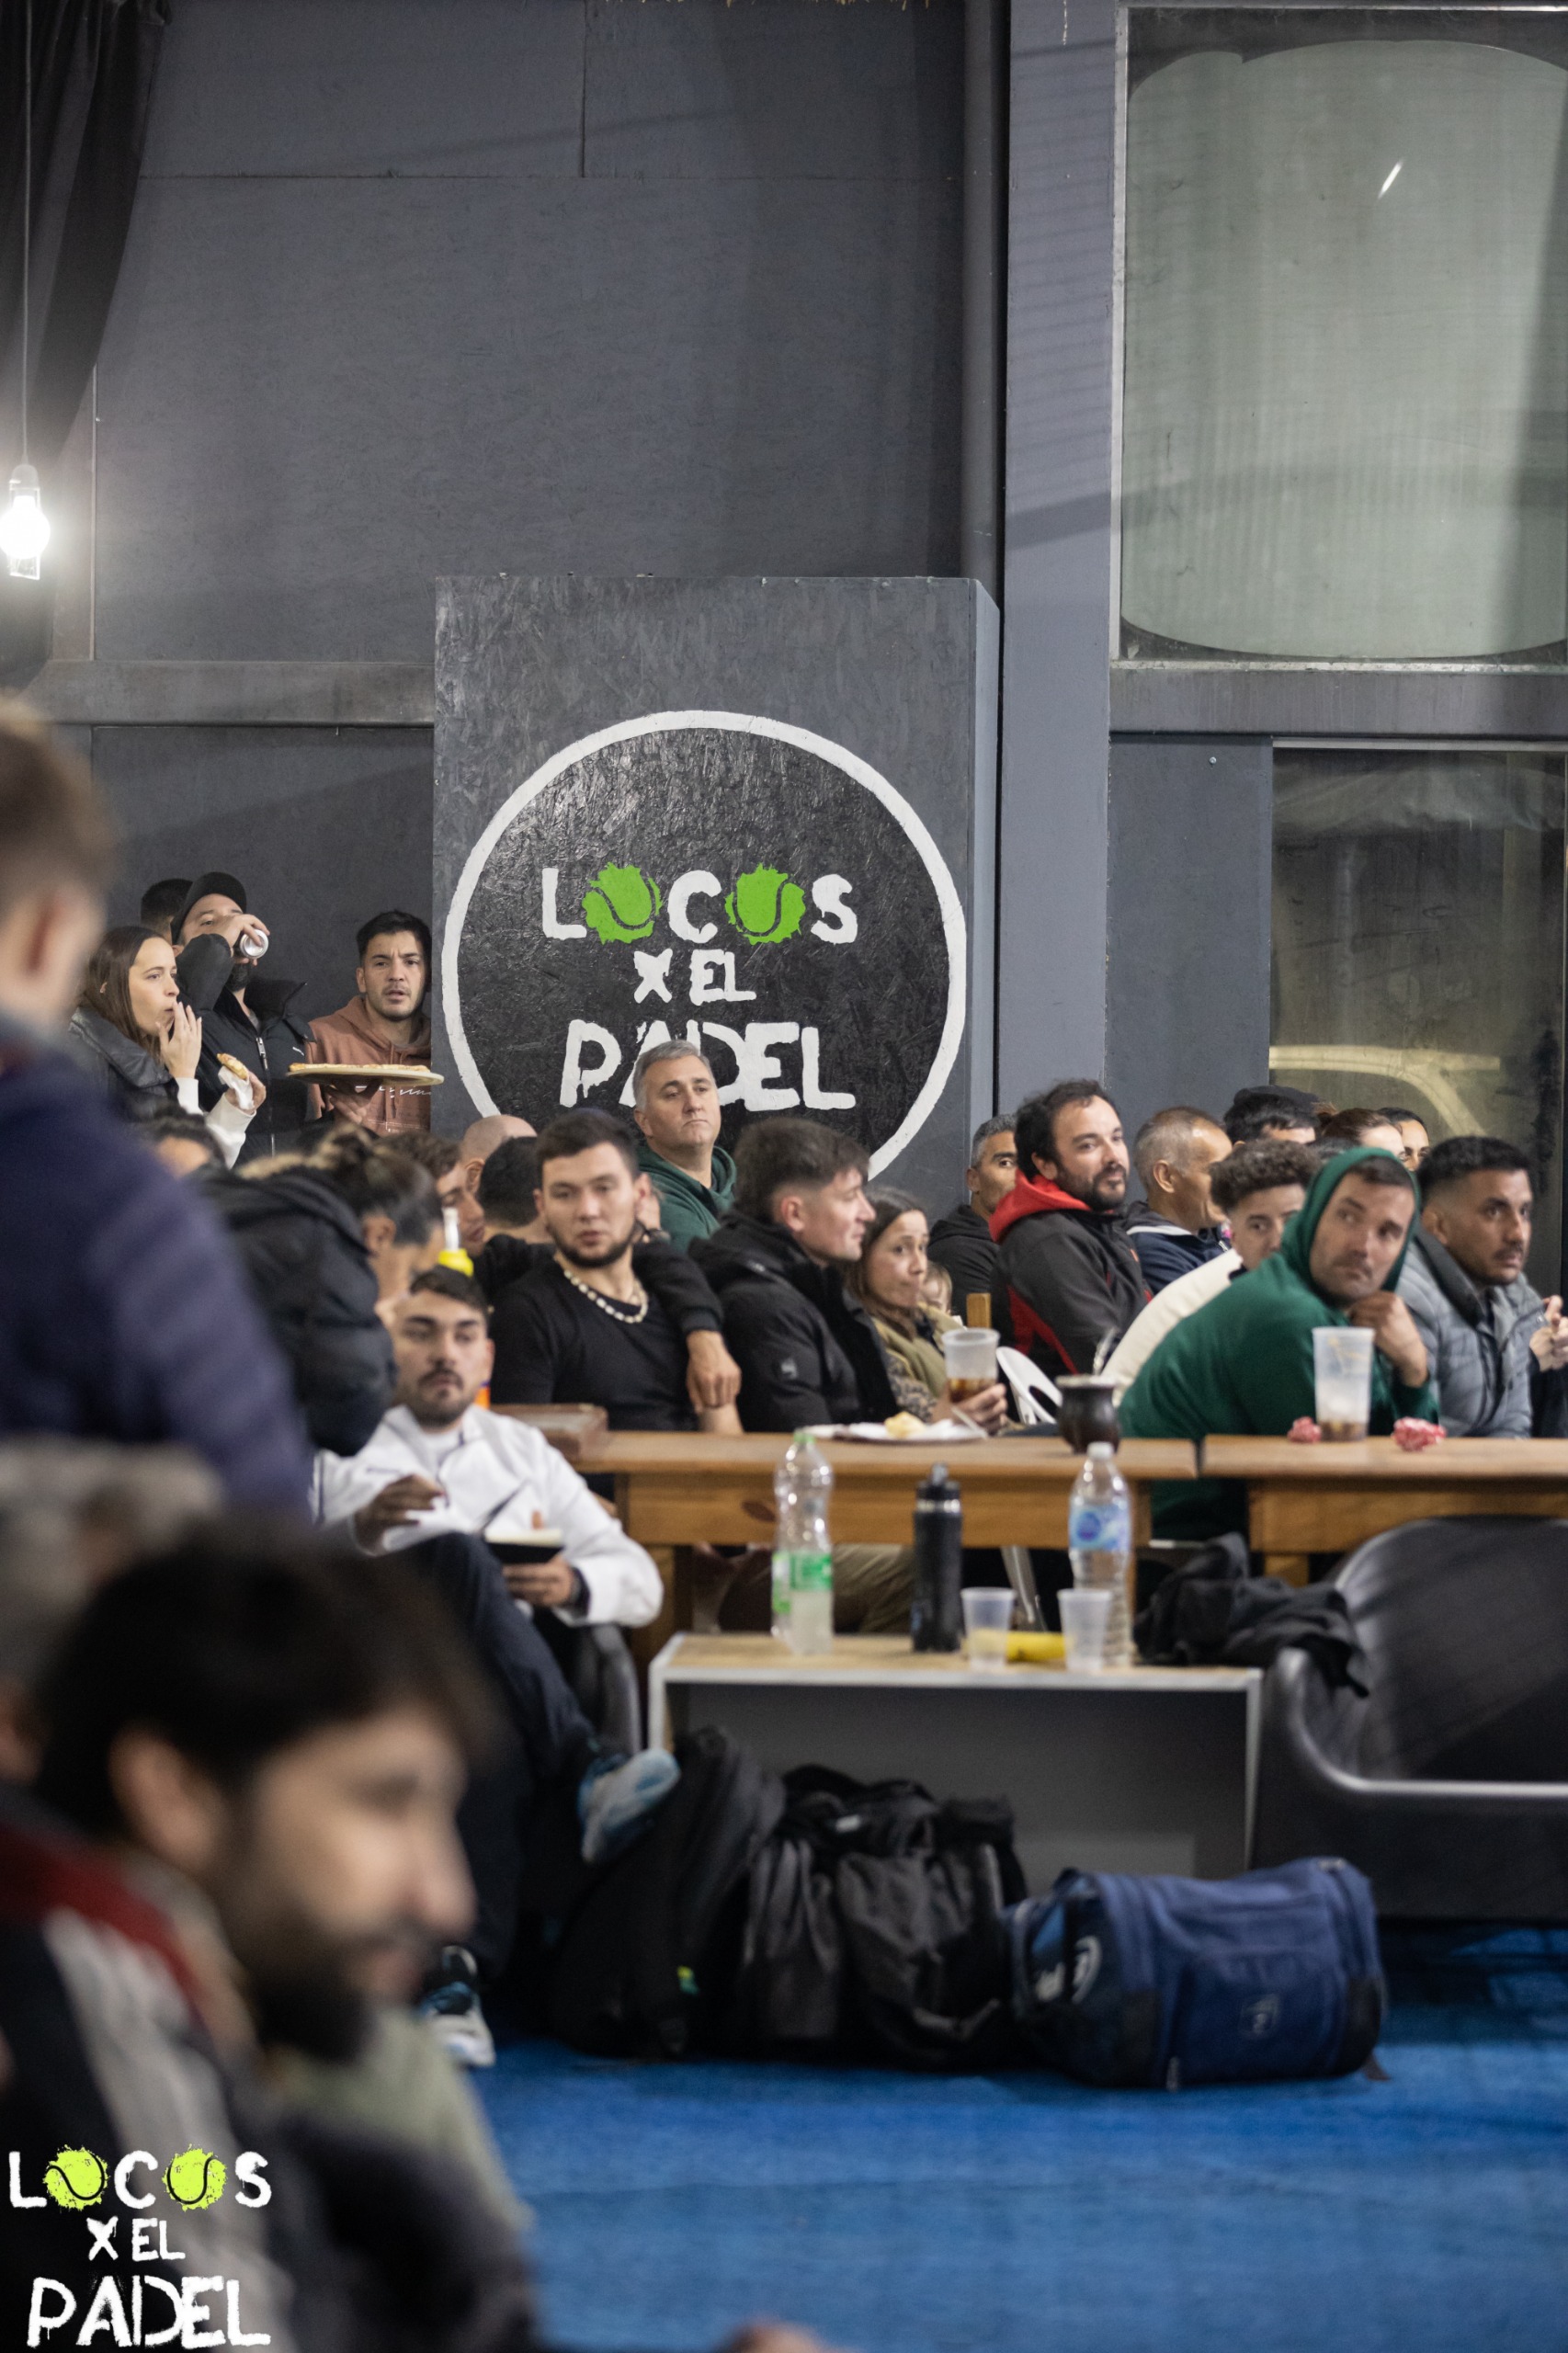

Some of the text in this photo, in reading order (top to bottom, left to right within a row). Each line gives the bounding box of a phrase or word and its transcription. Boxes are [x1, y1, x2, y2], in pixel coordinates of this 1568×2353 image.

[540, 861, 858, 946] LOCOS
[633, 948, 756, 1006] X EL
